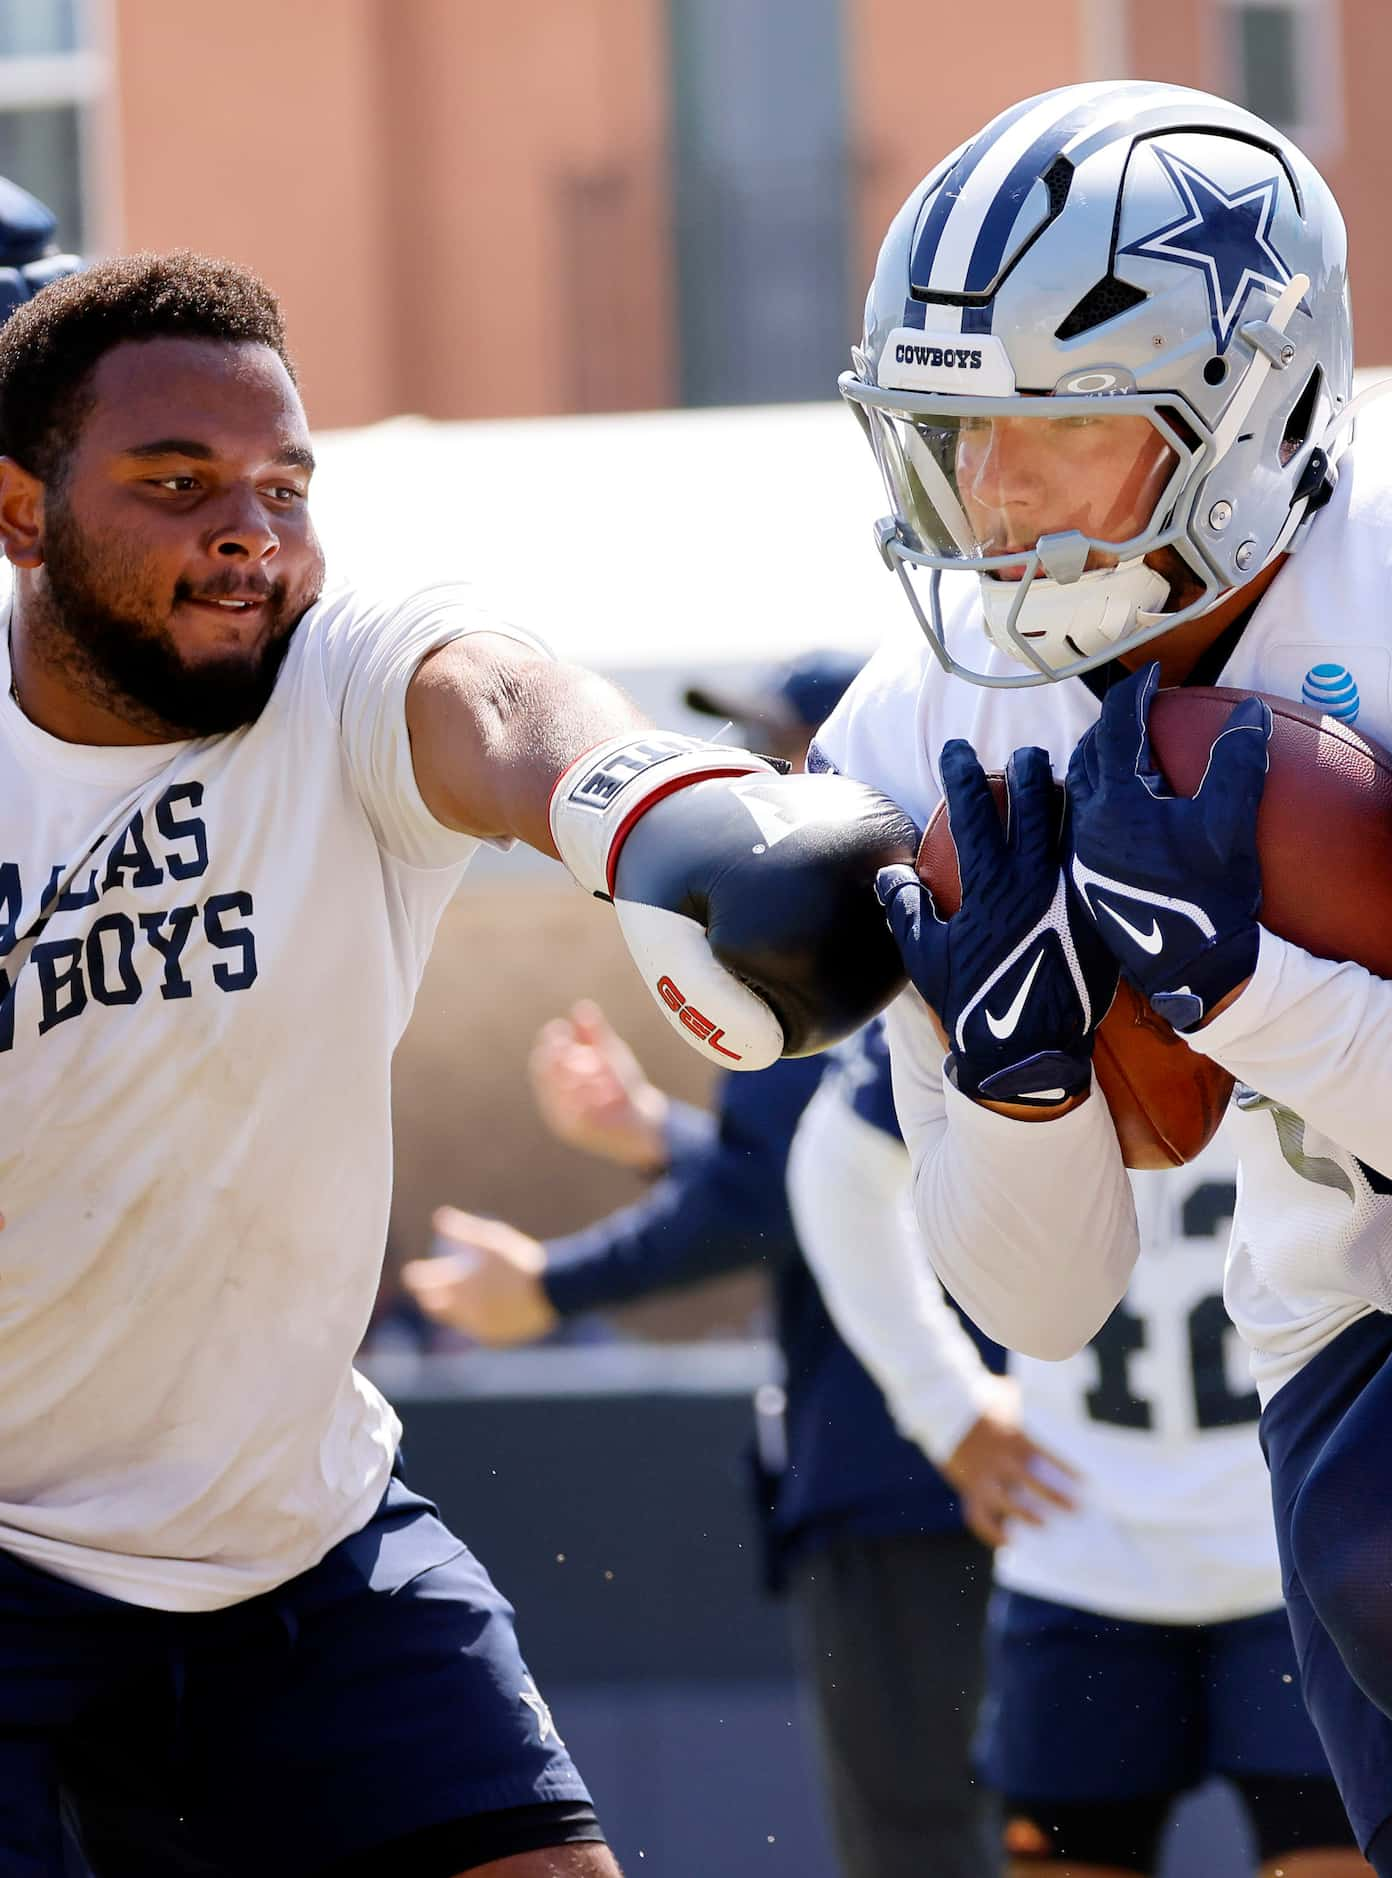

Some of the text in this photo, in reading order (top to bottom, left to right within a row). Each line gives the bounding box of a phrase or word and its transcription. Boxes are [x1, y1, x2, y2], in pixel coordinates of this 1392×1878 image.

[895, 344, 982, 369] COWBOYS
[0, 890, 258, 1050] BOYS
[657, 976, 742, 1061] GEL
